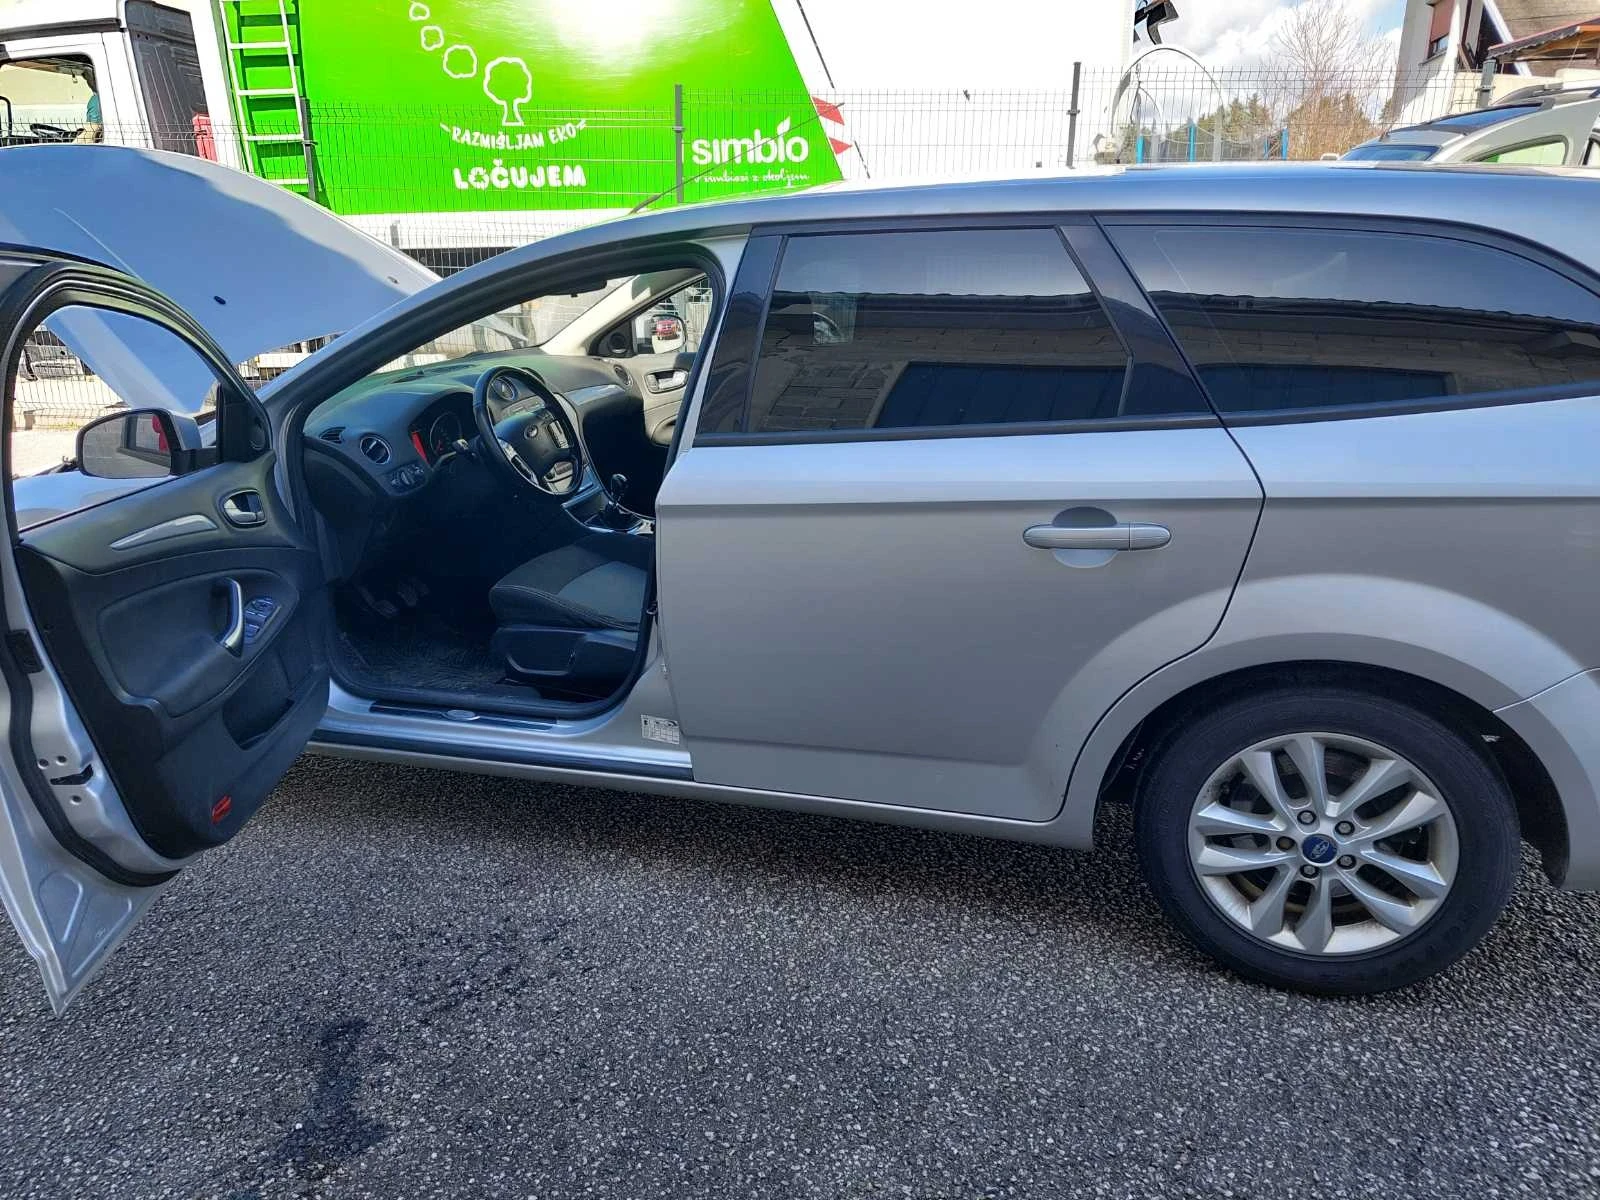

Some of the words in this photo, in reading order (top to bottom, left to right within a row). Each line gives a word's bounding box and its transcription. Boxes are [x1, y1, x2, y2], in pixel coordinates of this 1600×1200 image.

[548, 122, 577, 145] EKO
[691, 116, 809, 165] simbio
[453, 158, 587, 190] LOČUJEM
